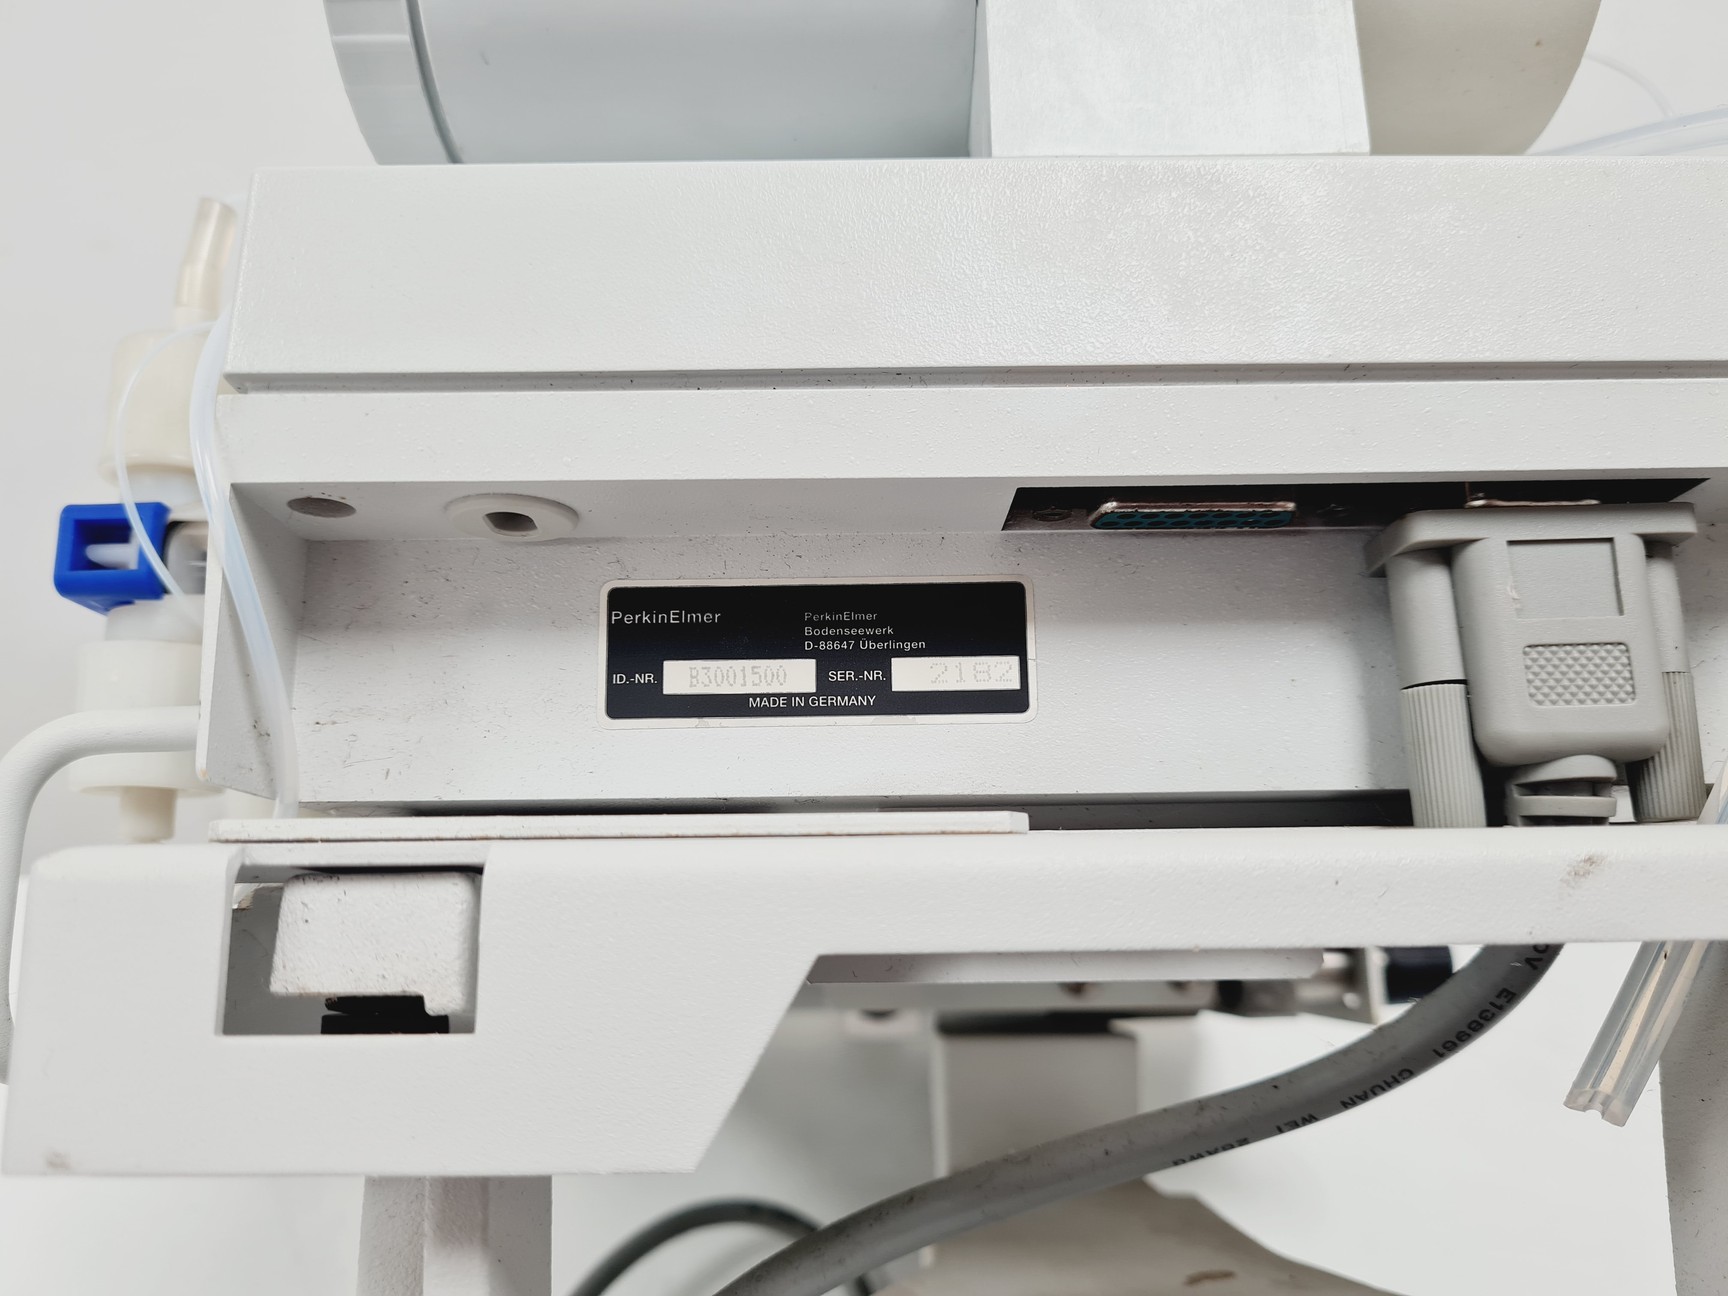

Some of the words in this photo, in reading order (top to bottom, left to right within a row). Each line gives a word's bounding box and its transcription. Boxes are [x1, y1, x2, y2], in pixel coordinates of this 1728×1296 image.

[611, 610, 721, 624] PerkinElmer
[804, 611, 877, 621] PerkinElmer
[804, 626, 894, 636] Bodenseewerk
[804, 640, 855, 651] D-88647
[859, 638, 926, 652] Überlingen
[612, 673, 658, 684] ID.-NR.
[689, 665, 788, 688] B3001500
[828, 670, 886, 682] SER.-NR.
[930, 661, 1013, 683] 2182
[749, 697, 787, 708] MADE
[791, 697, 805, 707] IN
[808, 695, 877, 707] GERMANY
[1340, 1068, 1414, 1109] CHUAN
